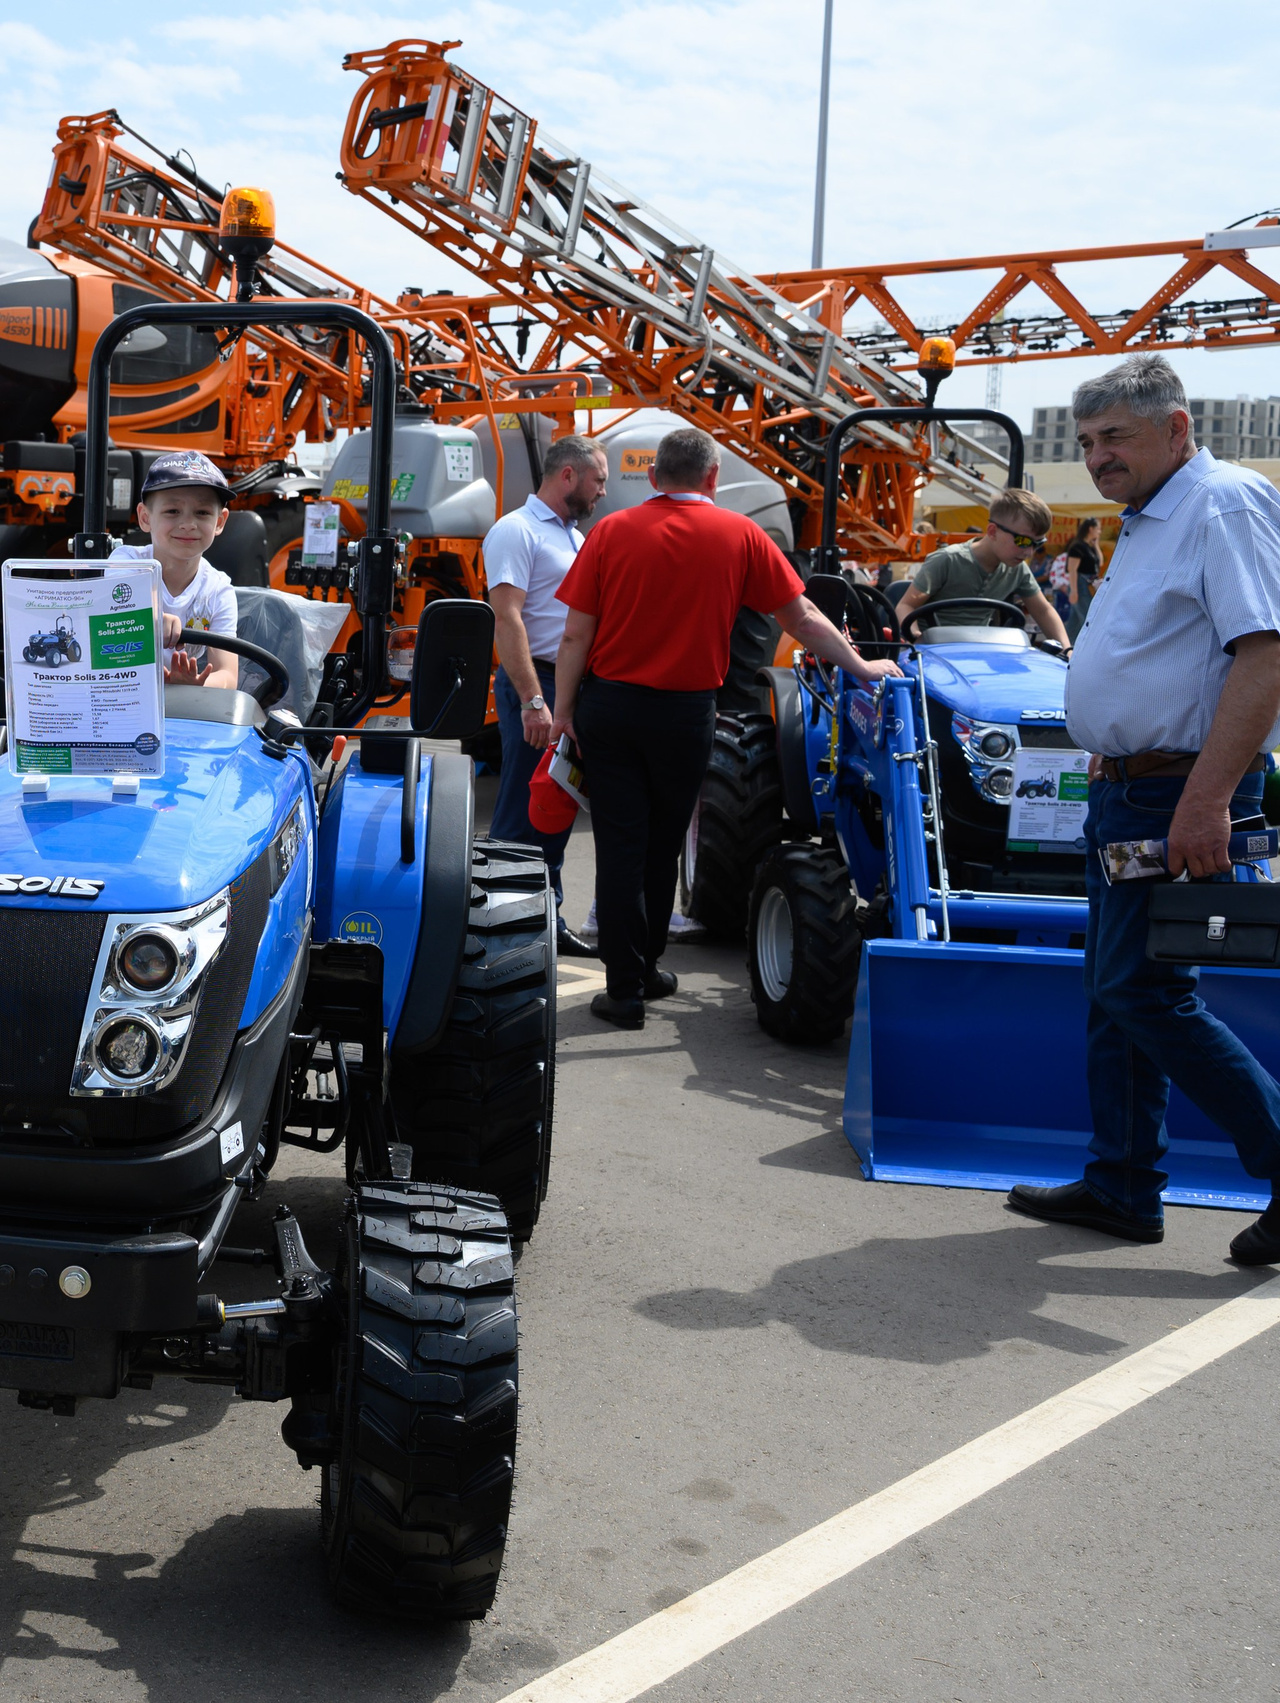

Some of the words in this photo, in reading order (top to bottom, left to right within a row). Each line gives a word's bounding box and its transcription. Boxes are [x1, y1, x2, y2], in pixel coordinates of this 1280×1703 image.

[3, 326, 30, 336] 4530
[637, 455, 656, 468] jac
[110, 603, 136, 611] Agrimatco
[105, 619, 135, 628] Трактор
[116, 625, 145, 634] 26-4WD
[33, 672, 72, 682] Трактор
[99, 671, 137, 680] 26-4WD
[1021, 710, 1066, 720] Soli
